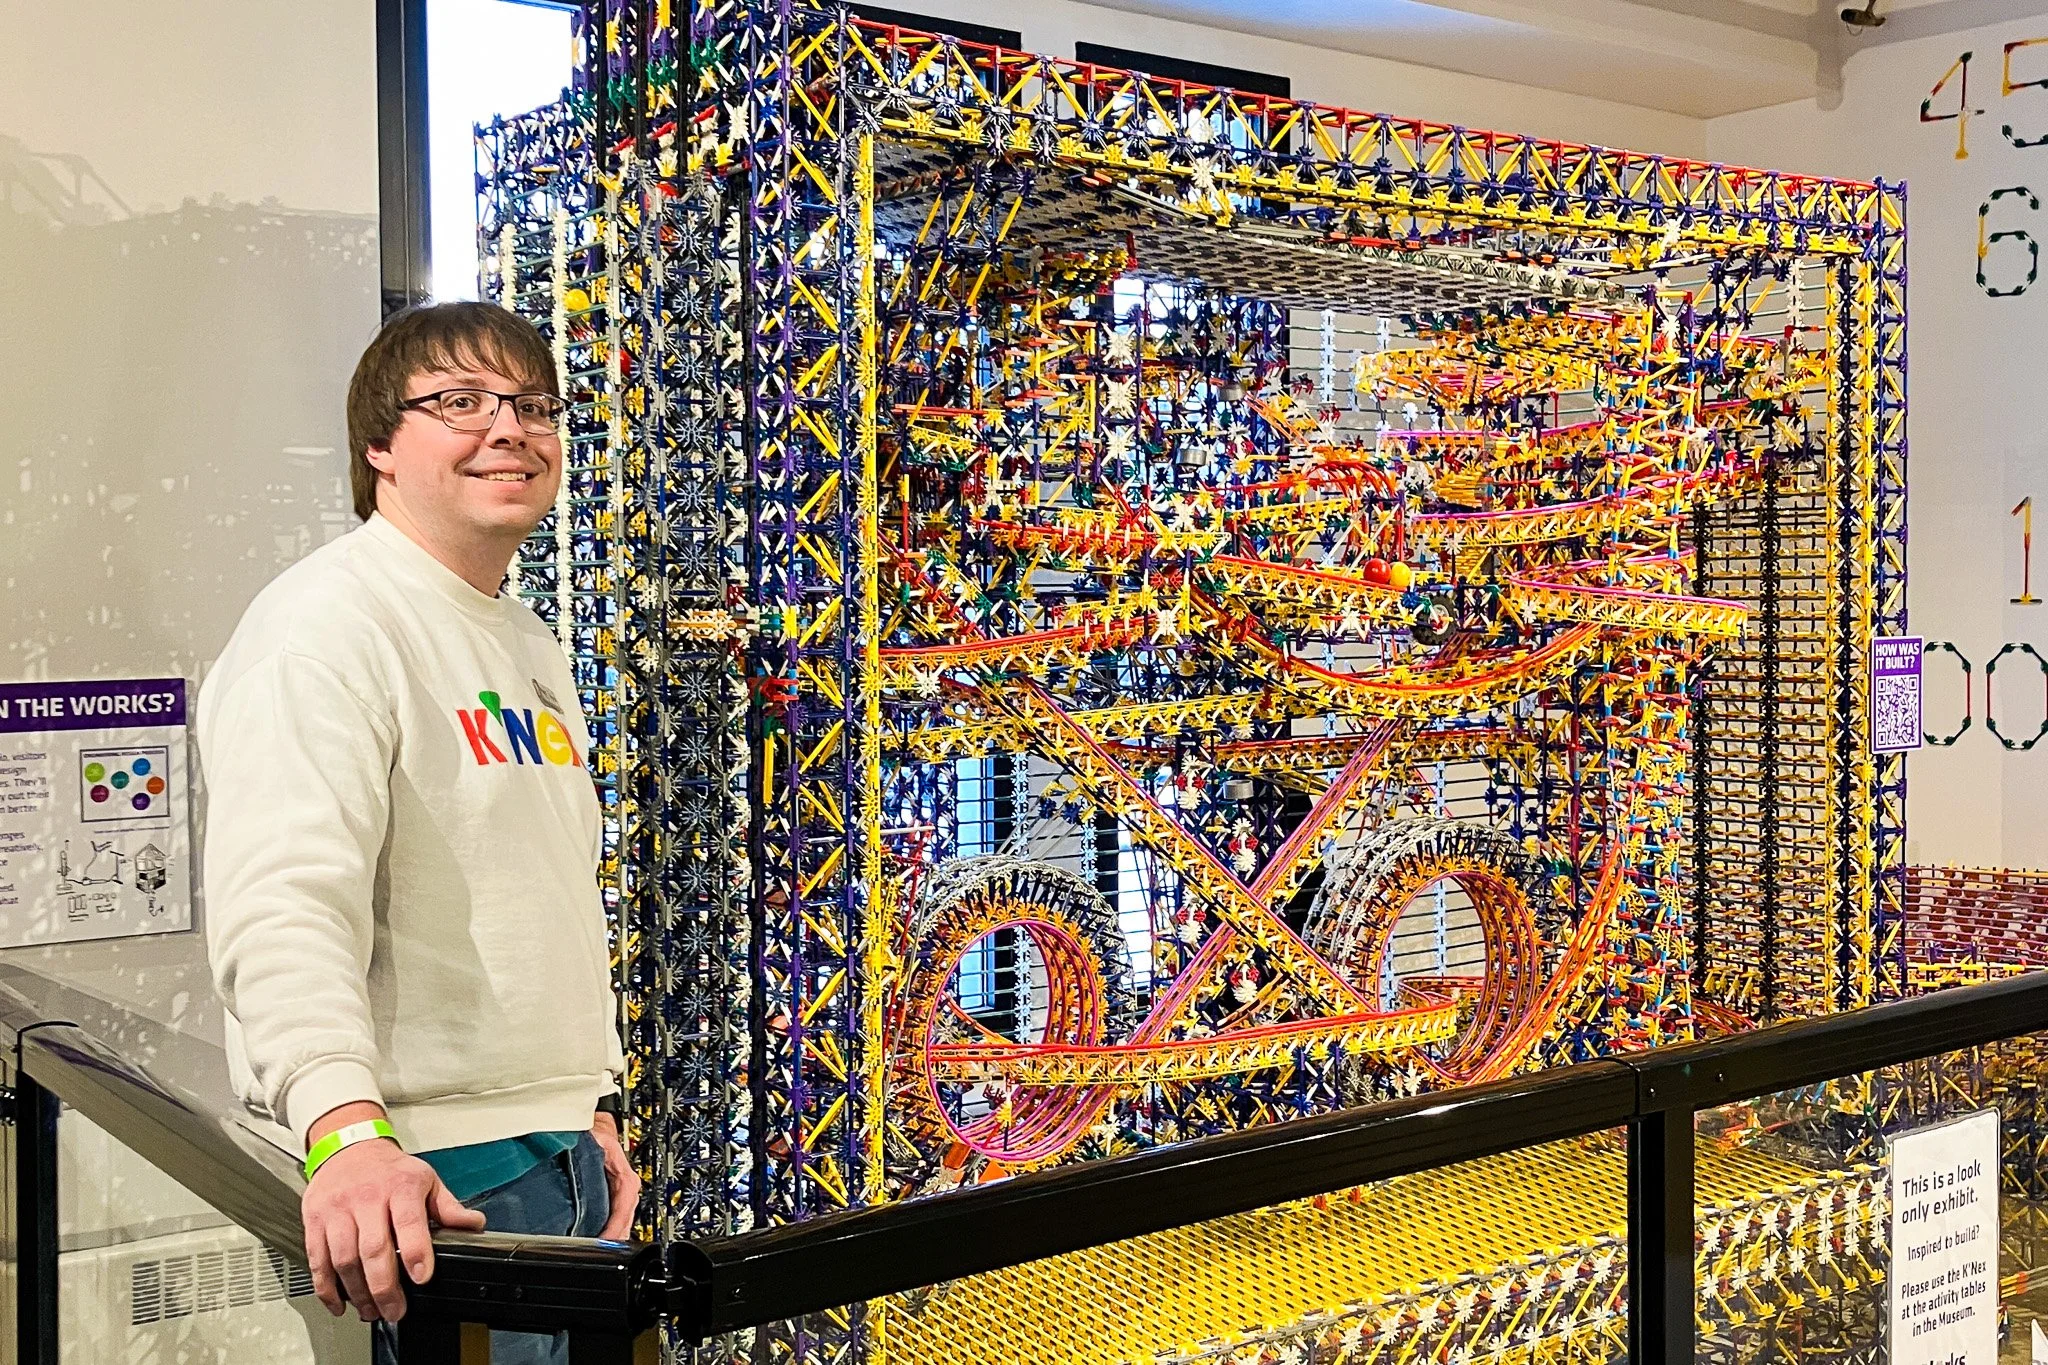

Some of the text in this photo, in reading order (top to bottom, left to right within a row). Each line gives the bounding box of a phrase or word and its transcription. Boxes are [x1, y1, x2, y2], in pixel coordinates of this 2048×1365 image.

[1875, 642, 1920, 657] HOW WAS
[1875, 655, 1916, 670] IT BUILT?
[15, 697, 65, 718] THE
[69, 692, 176, 717] WORKS?
[1902, 1159, 1981, 1198] This is a look
[1902, 1186, 1978, 1224] only exhibit.
[1908, 1224, 1980, 1261] Inspired to build?
[1901, 1261, 1987, 1300] Please use the K'Nex
[1901, 1280, 1986, 1320] at the activity tables
[1912, 1306, 1976, 1337] in the Museum.
